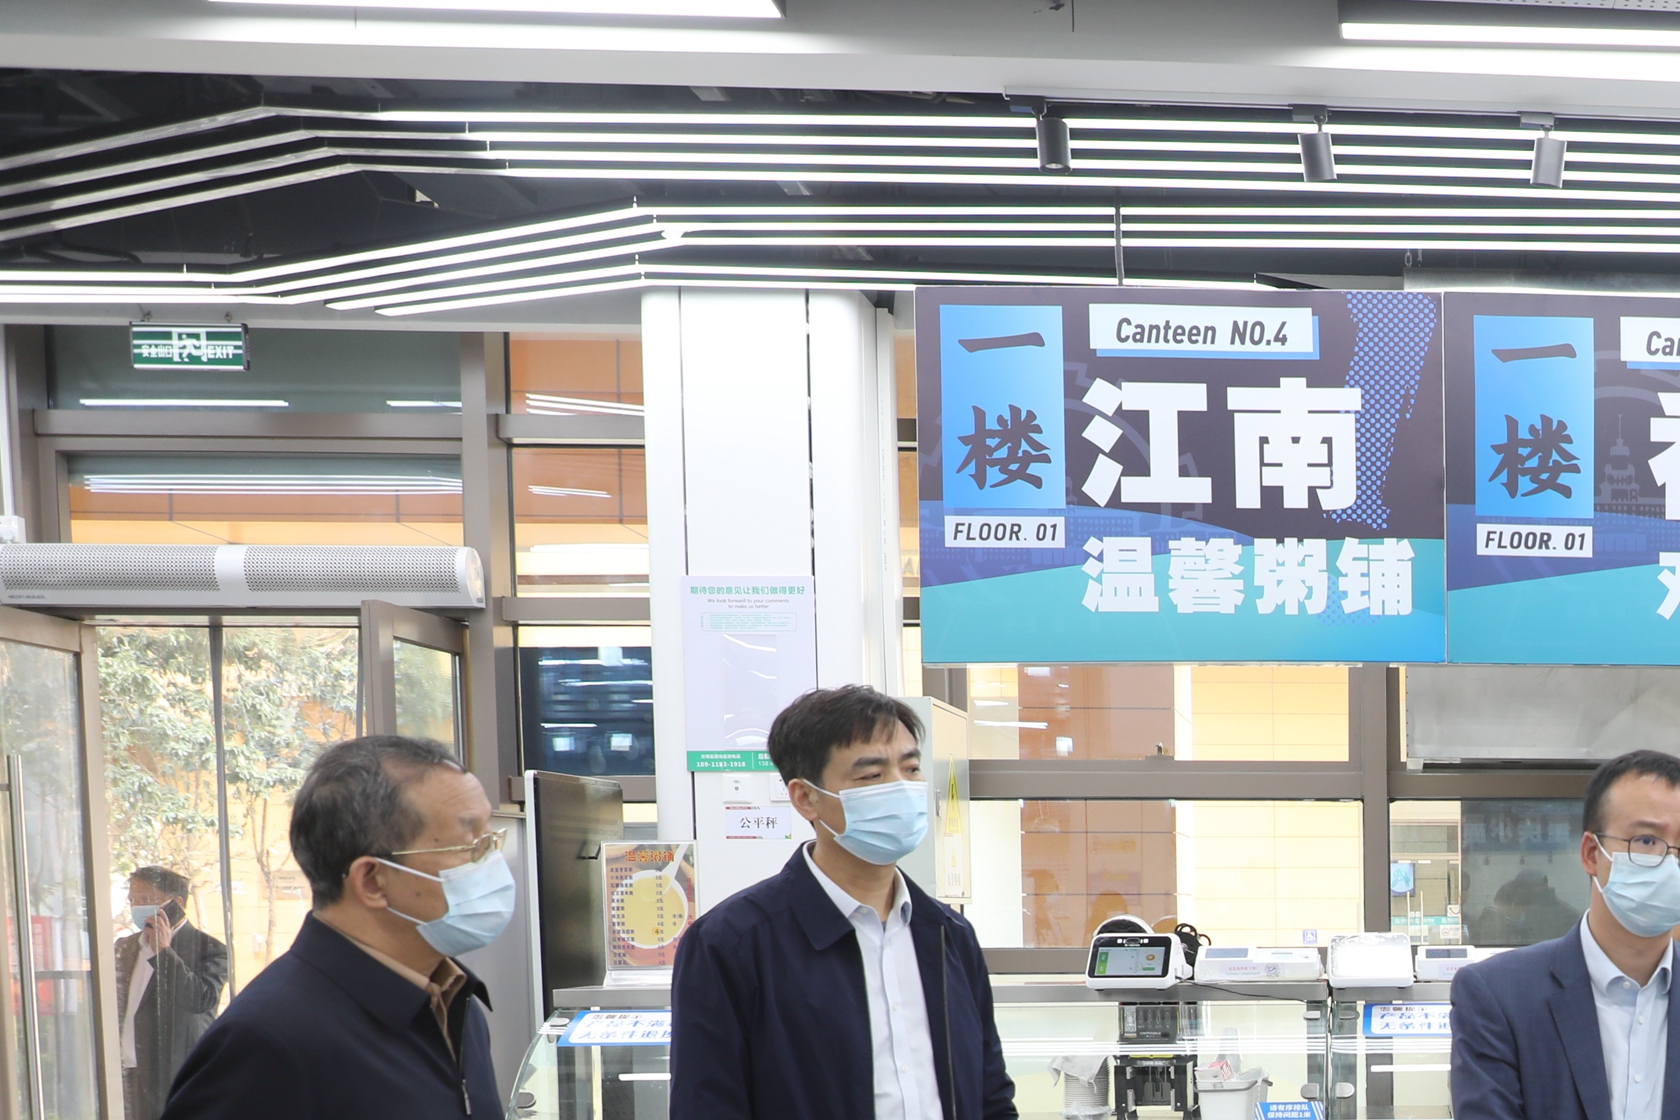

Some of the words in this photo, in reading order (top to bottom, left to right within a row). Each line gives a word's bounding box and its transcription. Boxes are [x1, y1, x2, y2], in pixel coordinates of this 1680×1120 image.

[1115, 317, 1217, 346] Canteen
[1229, 320, 1289, 347] NO.4
[141, 344, 173, 358] 安全出口
[207, 345, 235, 359] EXIT
[1081, 377, 1363, 510] 江南
[1034, 522, 1059, 543] 01
[1562, 531, 1587, 552] 01
[1081, 535, 1416, 616] 温馨粥铺
[690, 585, 806, 595] 期待您的意见让我们做得更好
[740, 816, 778, 829] 公平秤
[585, 1020, 671, 1028] 产品不满
[1269, 1103, 1310, 1111] 请有序排队
